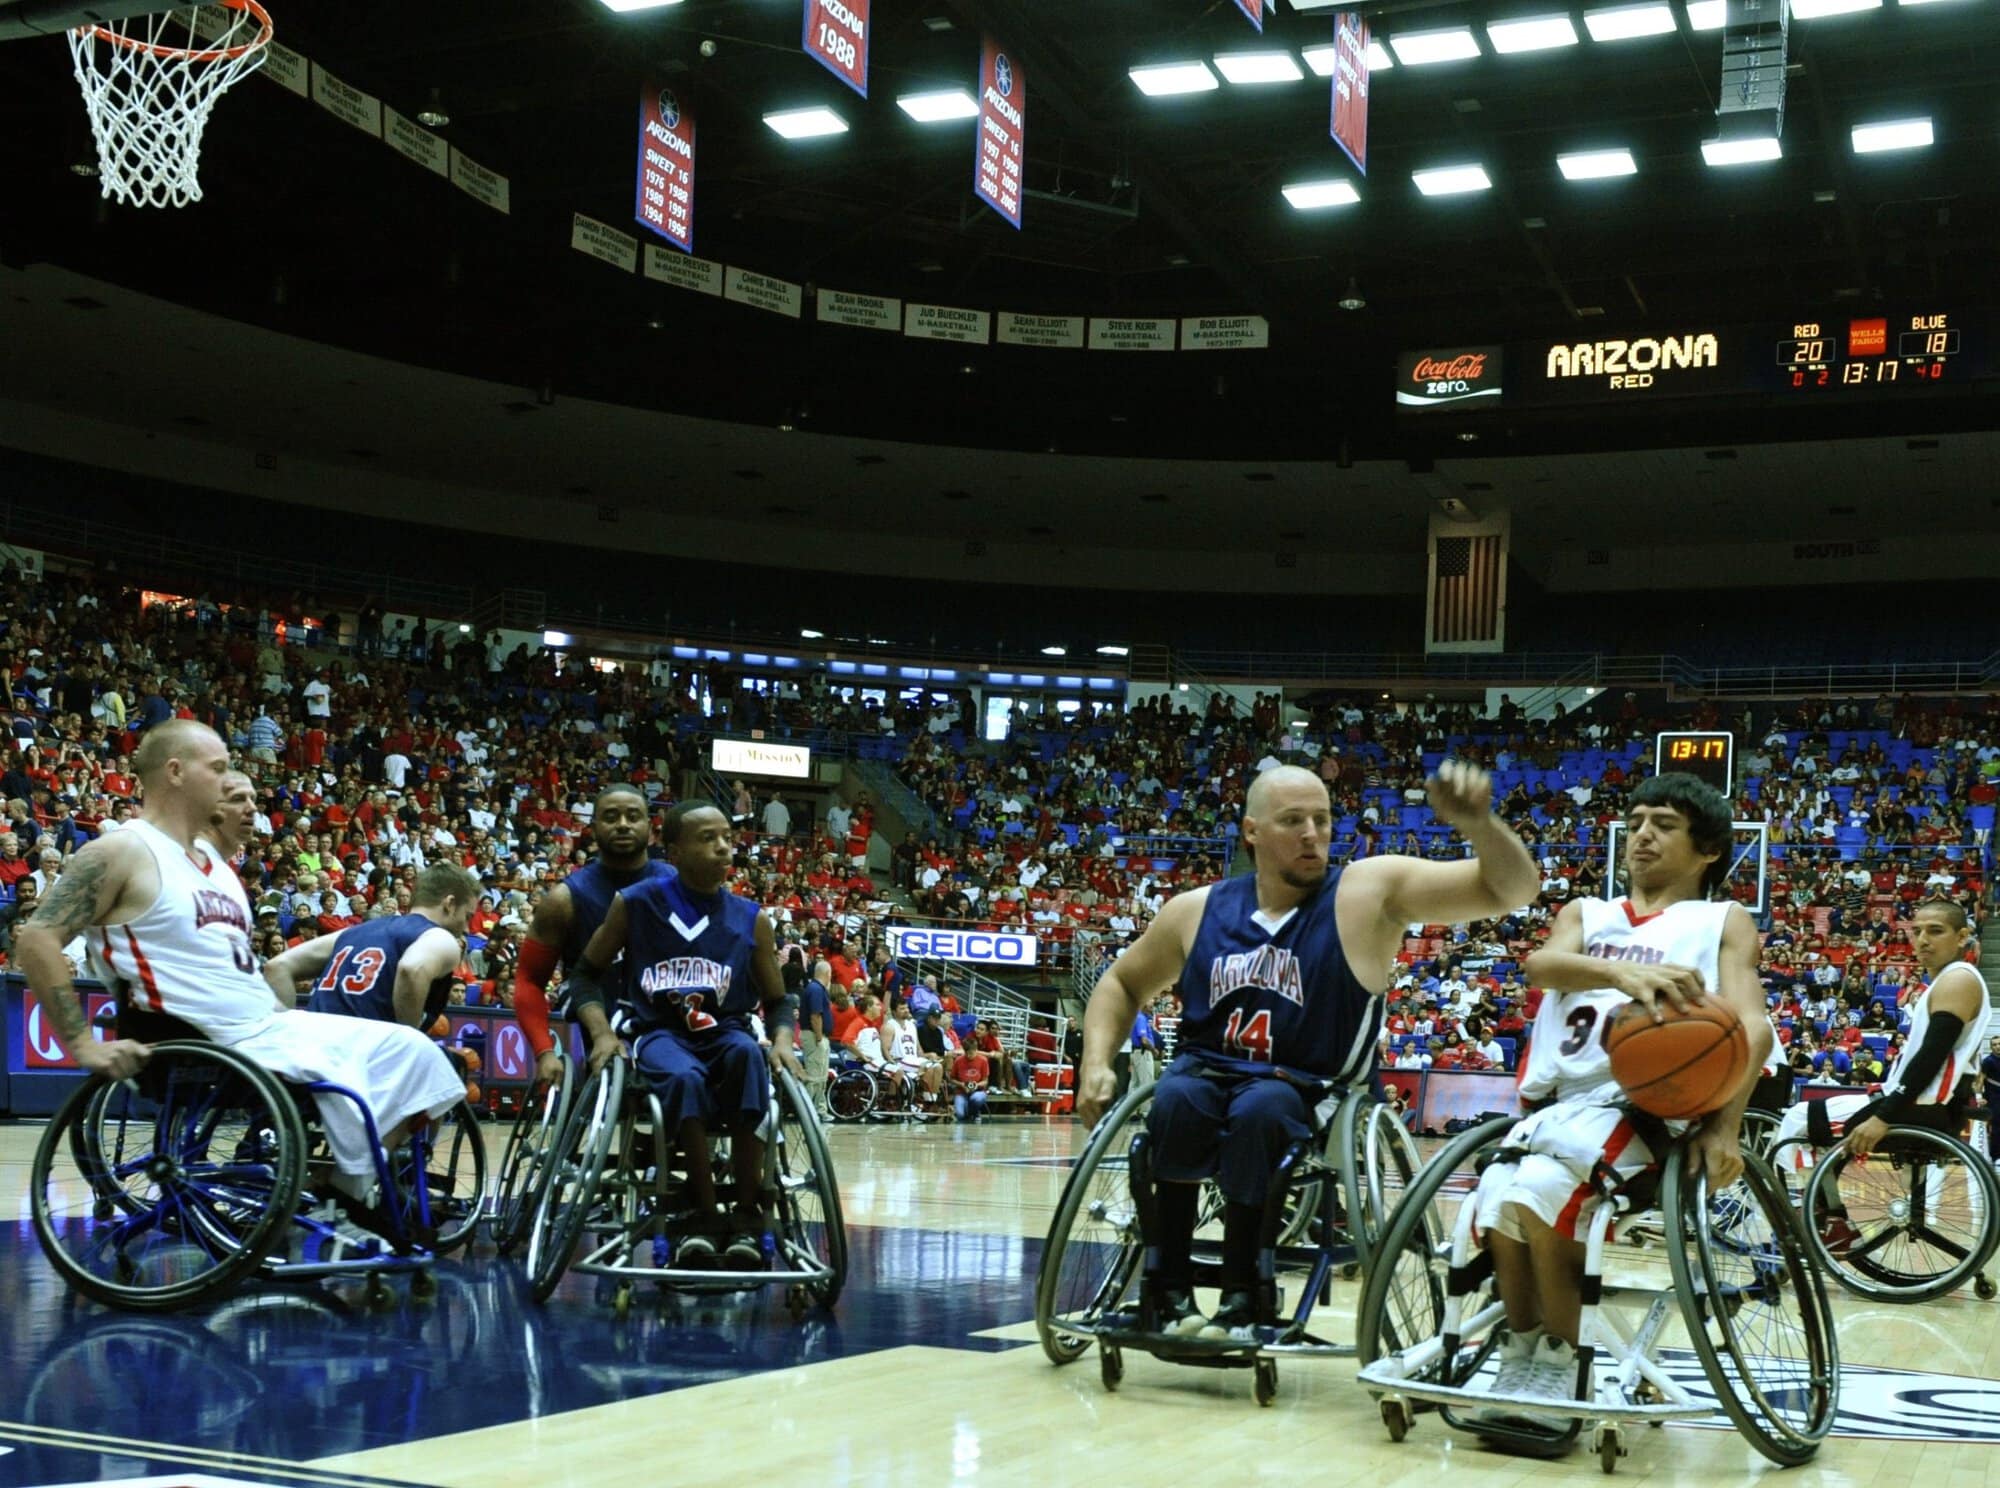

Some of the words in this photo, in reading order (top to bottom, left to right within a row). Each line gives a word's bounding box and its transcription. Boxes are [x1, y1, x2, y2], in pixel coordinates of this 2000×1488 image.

[819, 0, 864, 39] IZONA
[819, 23, 856, 70] 1988
[984, 85, 1021, 130] ARIZONA
[645, 119, 691, 159] ARIZONA
[984, 115, 1009, 145] SWEET
[1010, 139, 1019, 156] 16
[645, 148, 676, 175] SWEET
[678, 169, 688, 185] 16
[645, 168, 665, 190] 1976
[668, 182, 688, 204] 1988
[645, 186, 664, 207] 1989
[668, 200, 686, 221] 1991
[644, 204, 663, 225] 1994
[668, 217, 687, 239] 1996
[682, 256, 711, 273] REEVES
[742, 272, 764, 287] CHRIS
[765, 278, 787, 293] MILLS
[736, 283, 791, 304] M-BASKETBALL
[834, 293, 855, 304] SEAN
[828, 304, 889, 320] M-BASKETBALL
[919, 307, 936, 318] JUD
[937, 308, 978, 322] BUECHLER
[1014, 316, 1035, 326] SEAN
[1037, 317, 1068, 328] ELLIOTT
[1911, 315, 1947, 330] BLUE
[917, 319, 977, 332] M-BASKETBALL
[1009, 327, 1070, 337] M-BASKETBALL
[1107, 321, 1133, 331] STEVE
[1135, 321, 1157, 331] KERR
[1193, 330, 1255, 339] M-BASKETBALL
[1199, 320, 1217, 329] BOB
[1219, 319, 1250, 329] ELLIOTT
[1793, 323, 1820, 338] RED
[1850, 328, 1885, 338] WELLS
[1100, 332, 1162, 340] M-BASKETBALL
[1850, 337, 1884, 346] FARGO
[1926, 333, 1948, 354] 18
[1547, 333, 1718, 378] ARIZONA
[1794, 341, 1823, 362] 20
[1610, 373, 1653, 389] RED
[1843, 360, 1898, 384] 13:17
[1671, 741, 1724, 758] 13:17
[900, 931, 1023, 961] GEICO
[318, 945, 386, 995] 13
[1209, 943, 1304, 1009] ARIZONA
[641, 956, 732, 1008] ARIZONA
[1222, 1007, 1273, 1064] 14
[1560, 1004, 1618, 1056] 3
